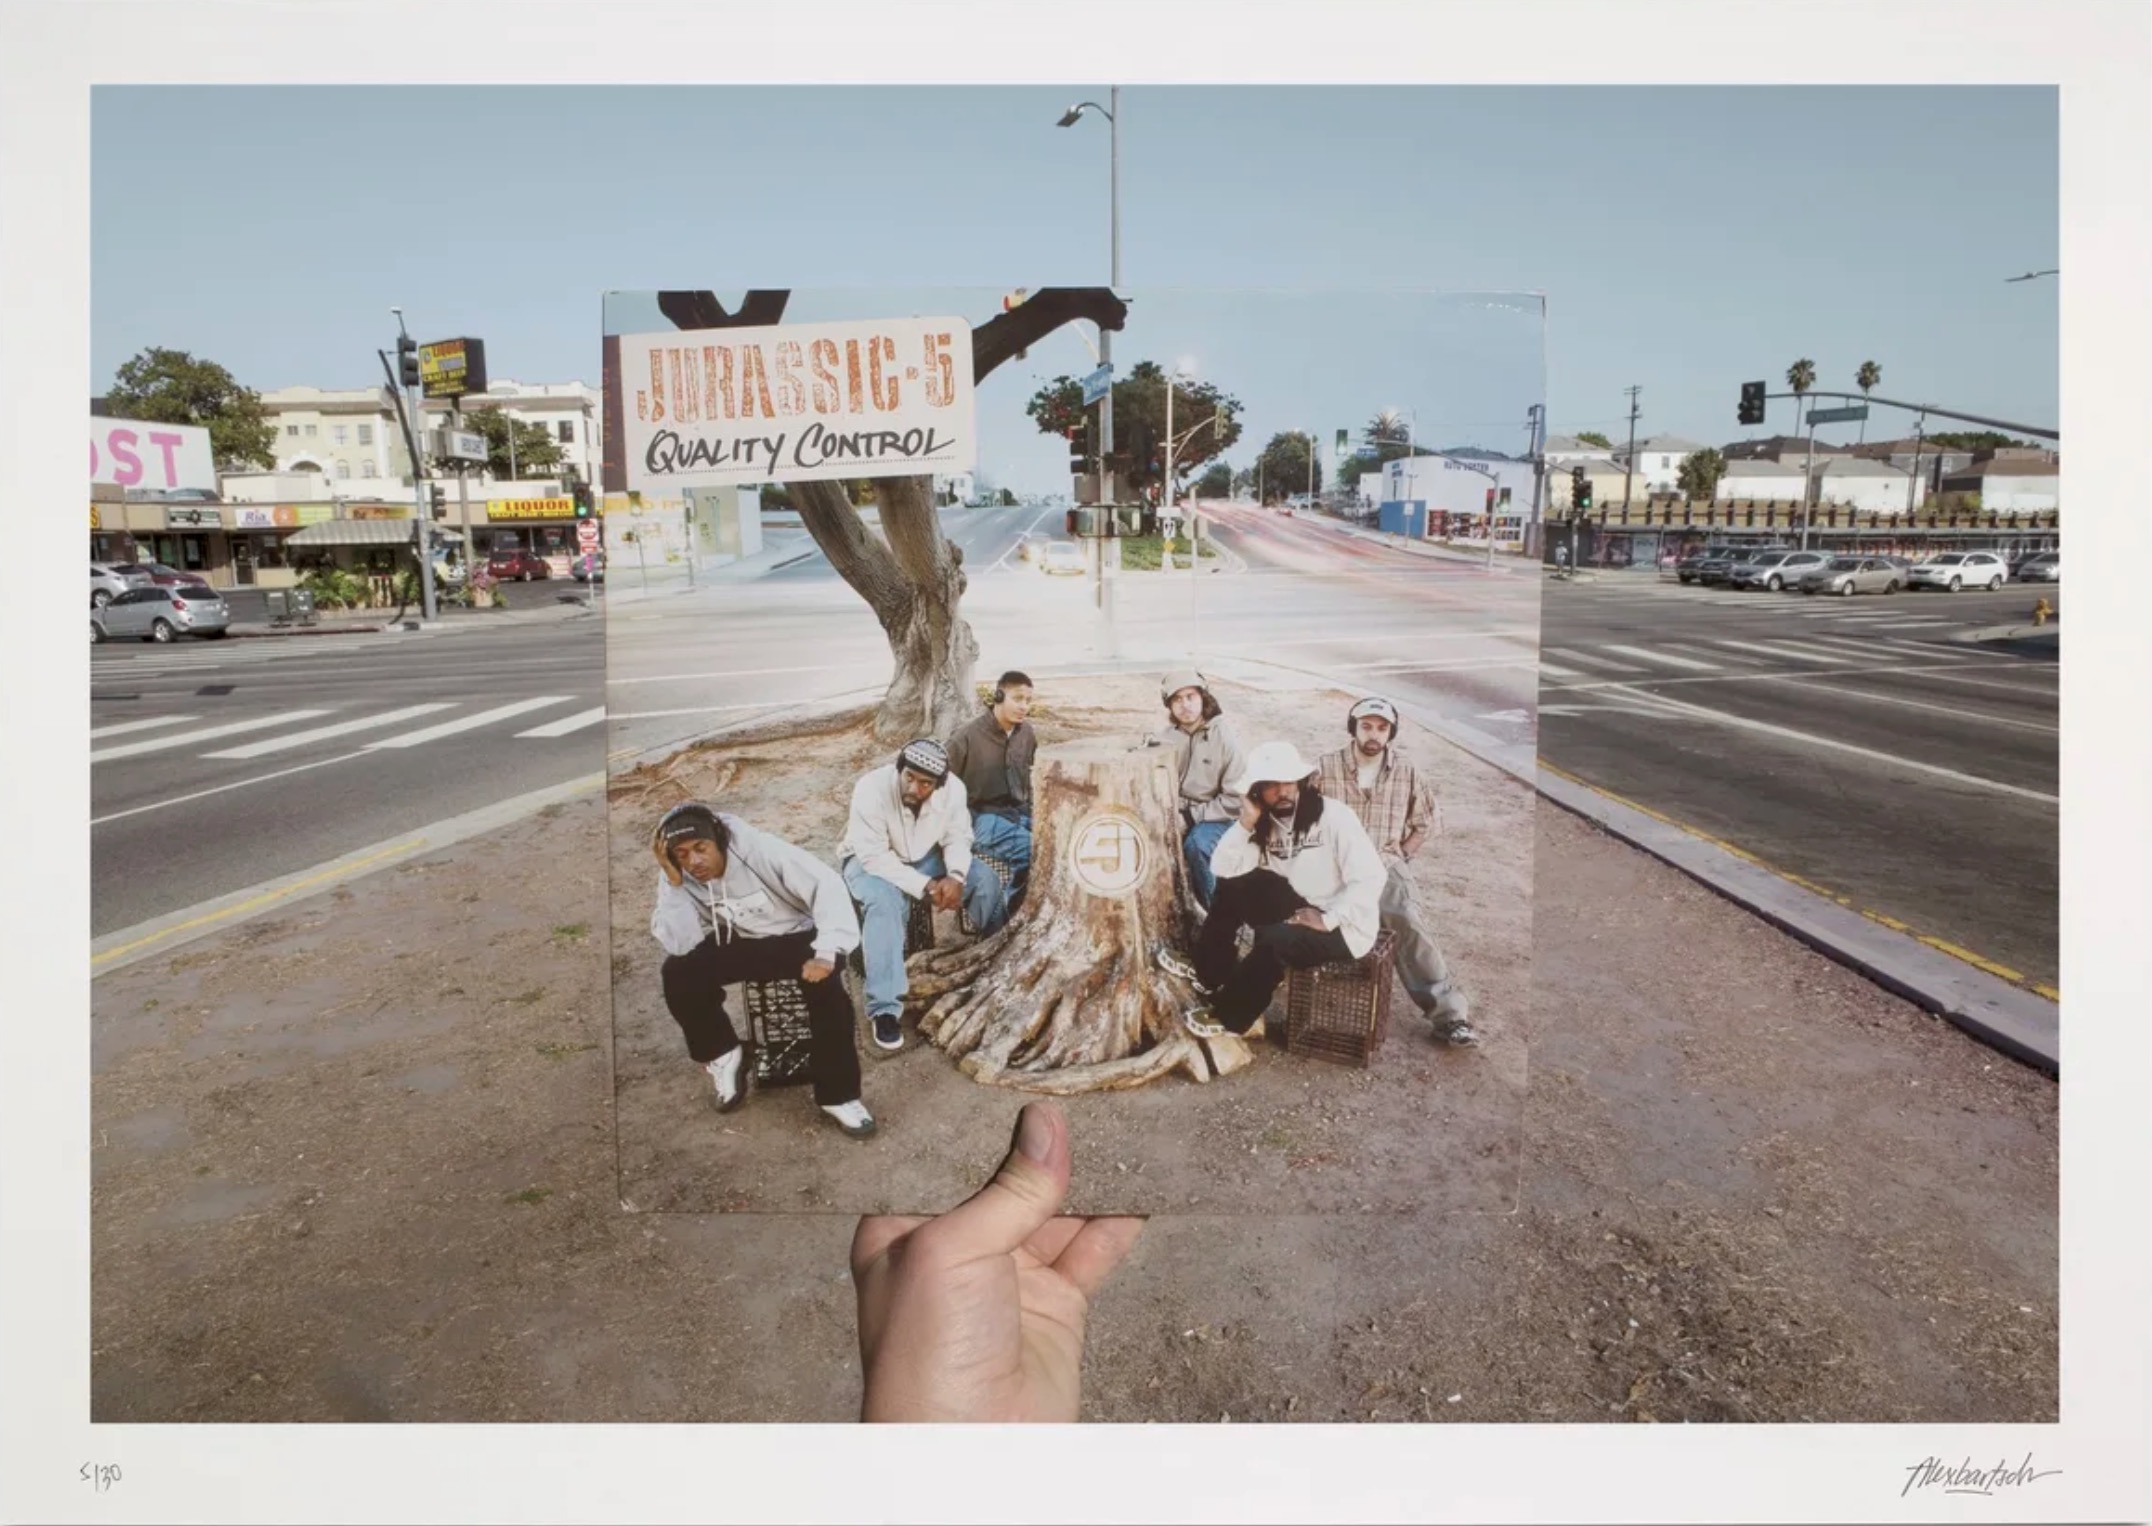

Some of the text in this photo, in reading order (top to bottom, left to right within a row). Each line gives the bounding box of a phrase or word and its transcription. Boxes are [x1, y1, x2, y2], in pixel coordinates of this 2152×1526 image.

[645, 422, 956, 475] QUALITY CONTROL
[505, 501, 569, 512] LIQUOR
[245, 509, 268, 522] Ria
